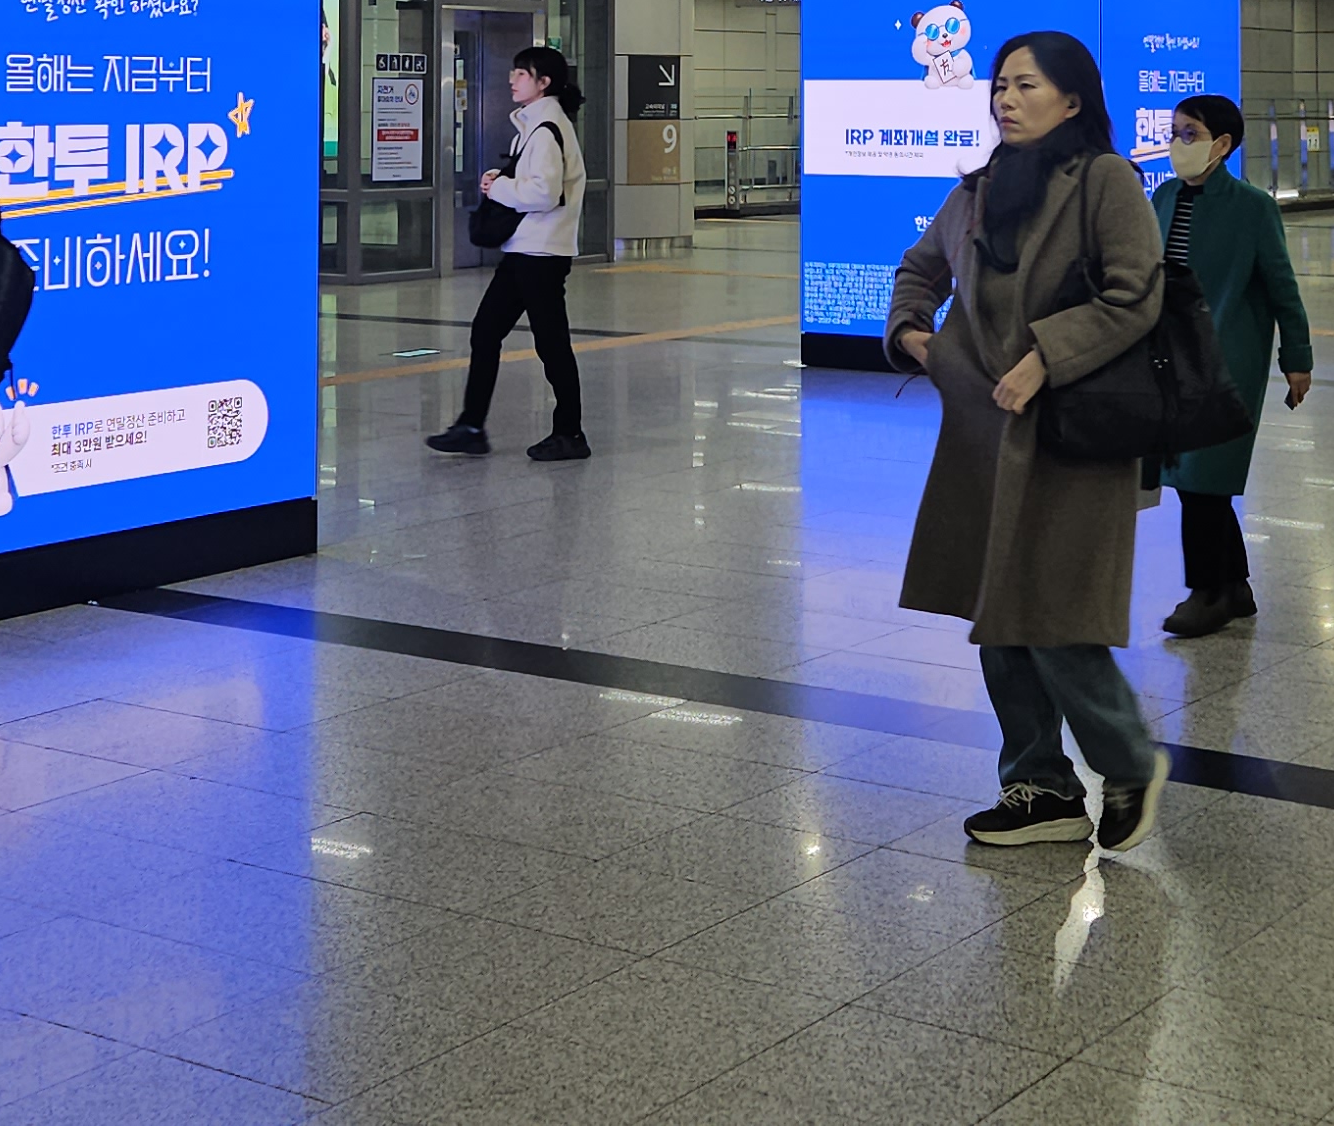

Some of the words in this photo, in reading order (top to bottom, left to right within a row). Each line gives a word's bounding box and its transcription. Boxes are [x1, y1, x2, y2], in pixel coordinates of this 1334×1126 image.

[6, 53, 95, 93] 올해는
[102, 55, 212, 93] 지금부터
[1138, 69, 1168, 93] 올해는
[1168, 69, 1206, 93] 지금부터
[662, 124, 677, 154] 9
[845, 128, 874, 145] IRP
[878, 128, 939, 146] 계좌개설
[943, 129, 980, 147] 완료!
[125, 122, 229, 195] IRP
[51, 423, 72, 440] 한투
[74, 419, 104, 436] IRP로
[106, 413, 146, 433] 연말정산
[147, 408, 186, 427] 준비하고
[51, 440, 72, 456] 최대
[74, 435, 102, 453] 3만원
[105, 430, 148, 450] 받으세요!
